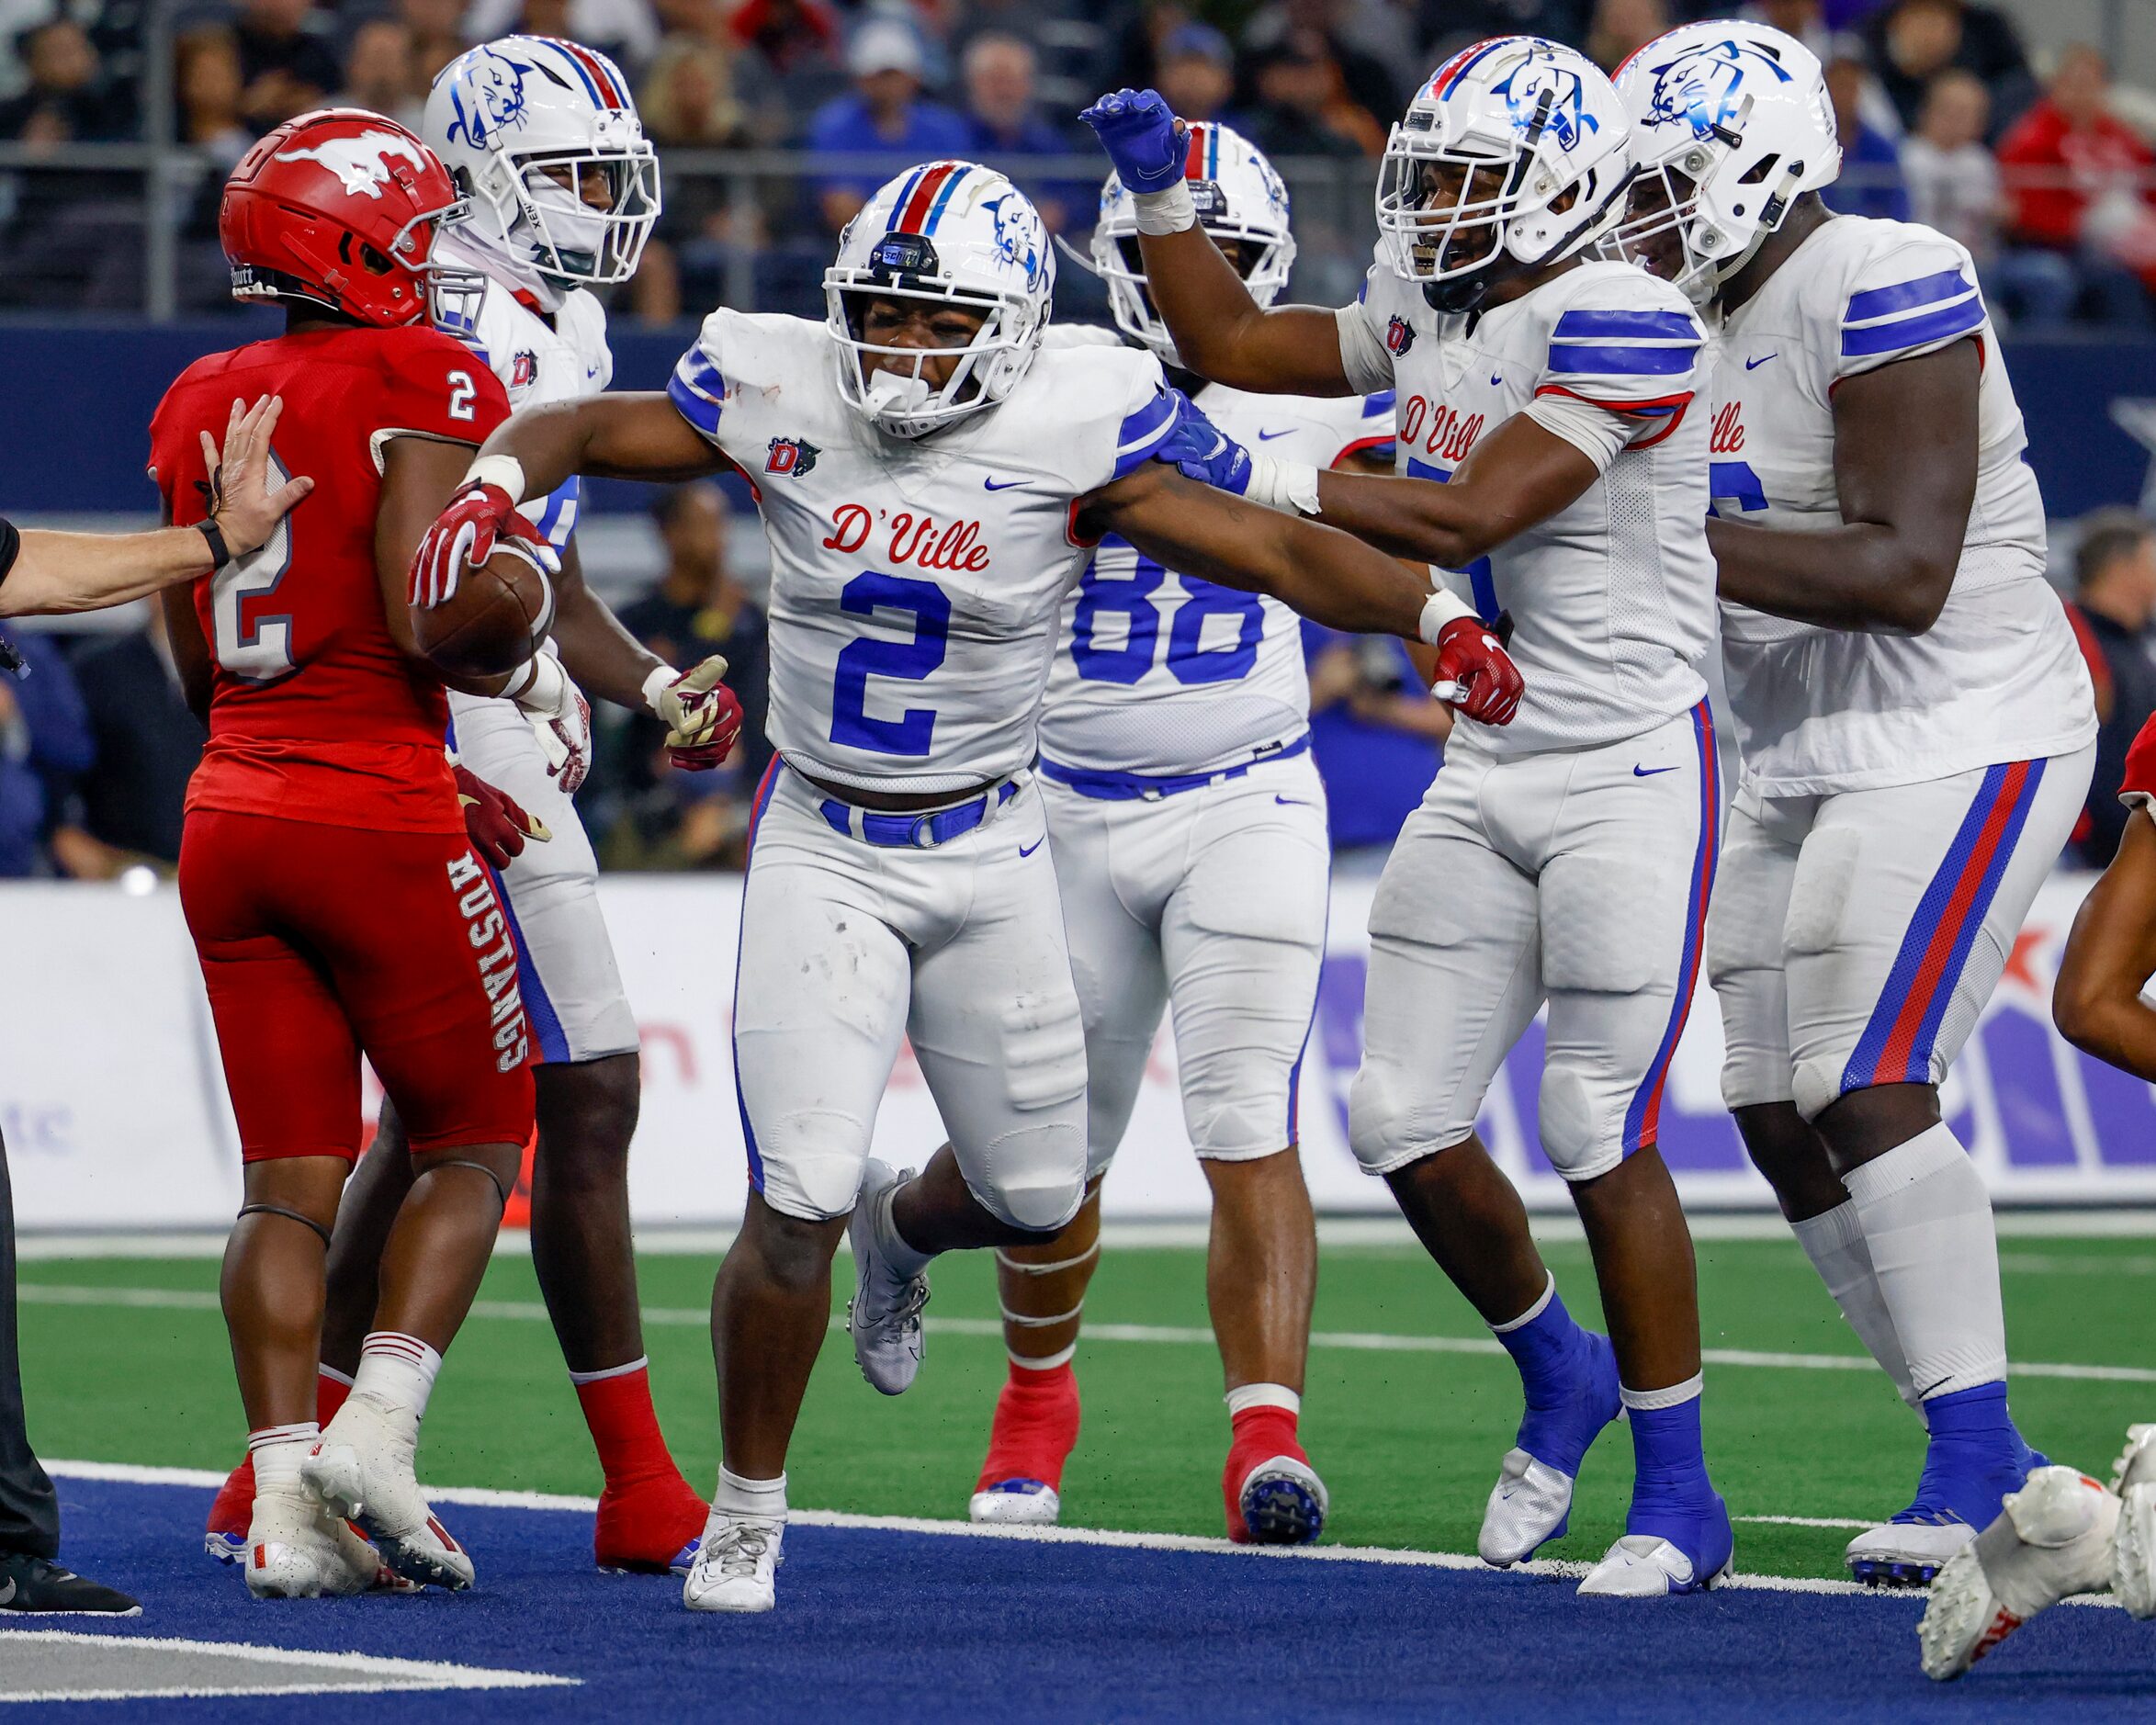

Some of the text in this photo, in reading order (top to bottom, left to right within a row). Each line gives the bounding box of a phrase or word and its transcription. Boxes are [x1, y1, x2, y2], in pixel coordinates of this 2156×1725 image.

[446, 369, 477, 422] 2
[1400, 395, 1484, 462] D'Vill
[822, 503, 990, 572] D'Ville
[829, 569, 952, 756] 2
[1070, 531, 1266, 686] 88
[446, 848, 530, 1074] MUSTANGS
